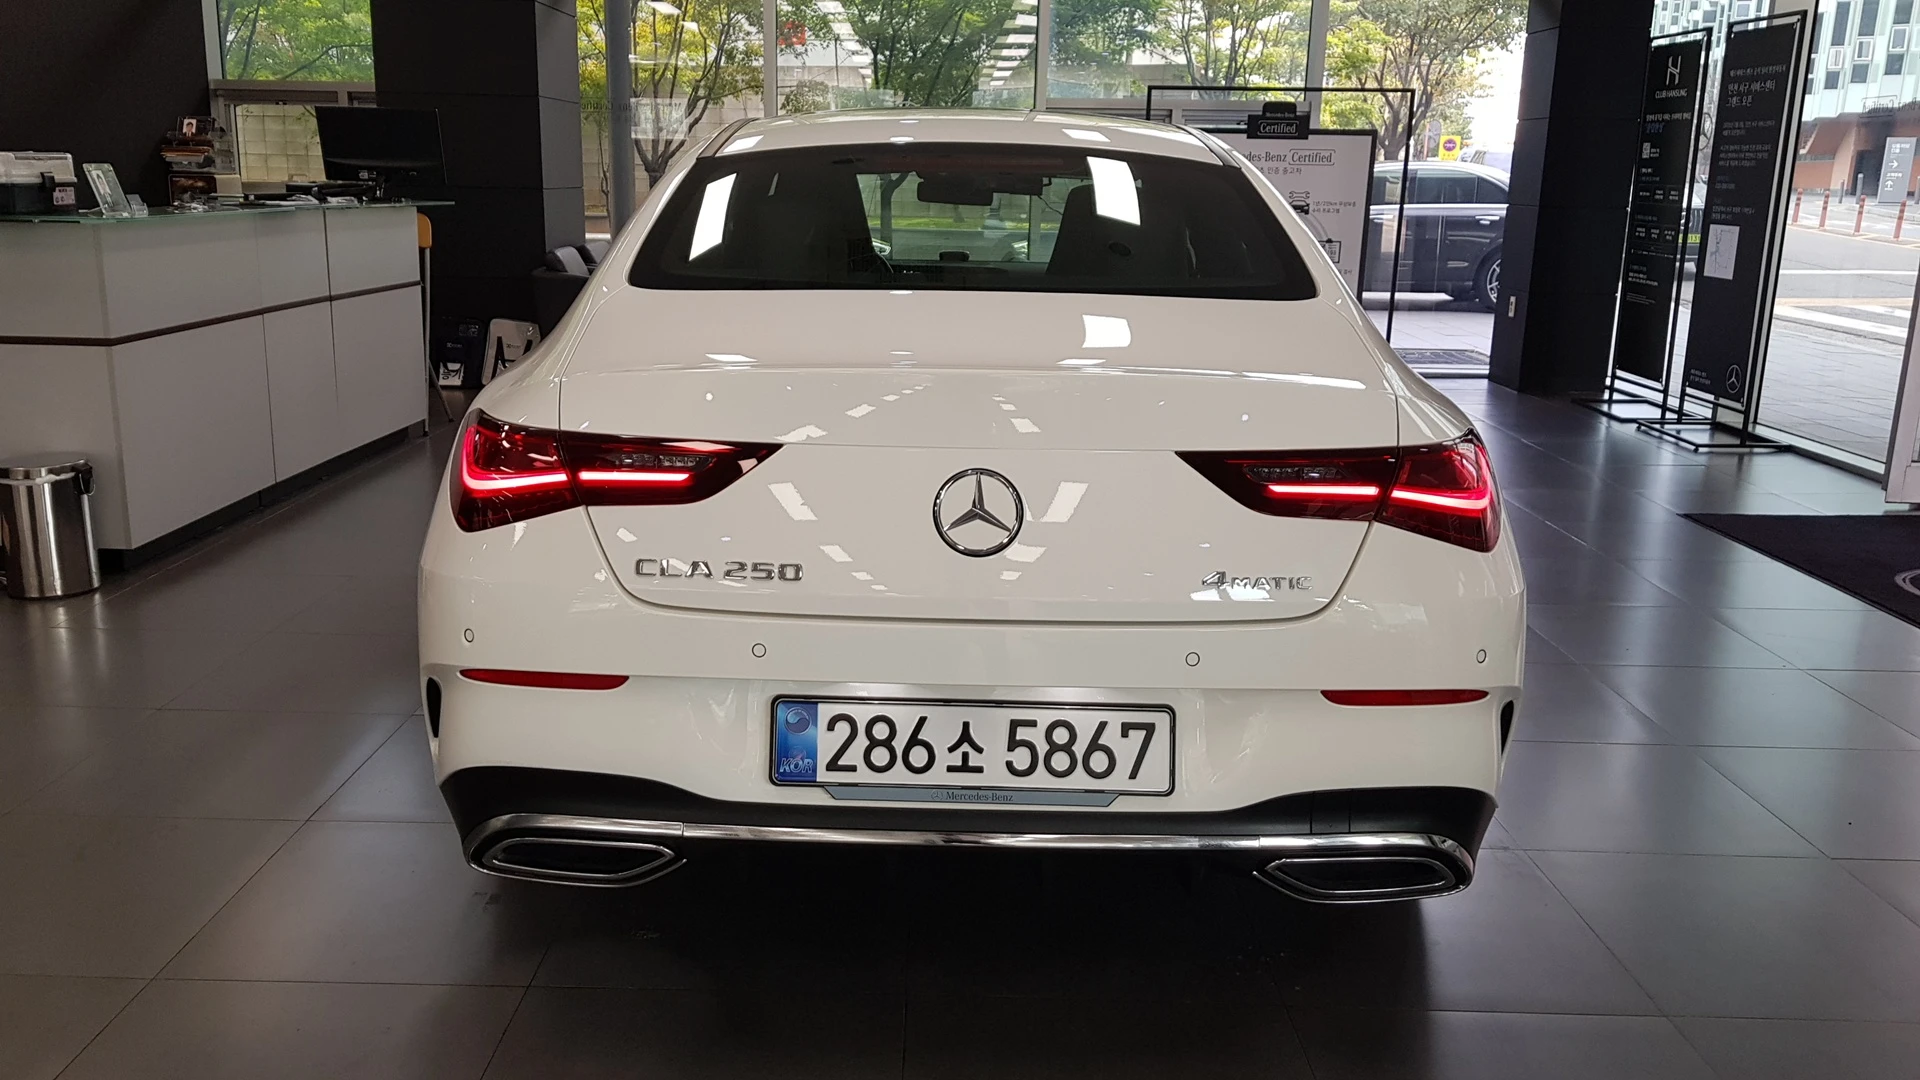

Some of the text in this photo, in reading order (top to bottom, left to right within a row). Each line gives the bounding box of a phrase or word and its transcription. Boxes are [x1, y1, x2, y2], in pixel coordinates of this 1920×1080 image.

[1654, 88, 1688, 99] CLUB HANSUNG
[1260, 122, 1296, 134] Certified
[1291, 151, 1333, 163] Certified
[1267, 166, 1280, 175] 인증
[1282, 166, 1303, 175] 중고차
[635, 558, 804, 581] CLA 250
[1201, 570, 1313, 590] 4MATIC
[1005, 718, 1157, 780] 5867
[779, 757, 814, 773] KOR
[945, 791, 1014, 802] Mercedes-Benz
